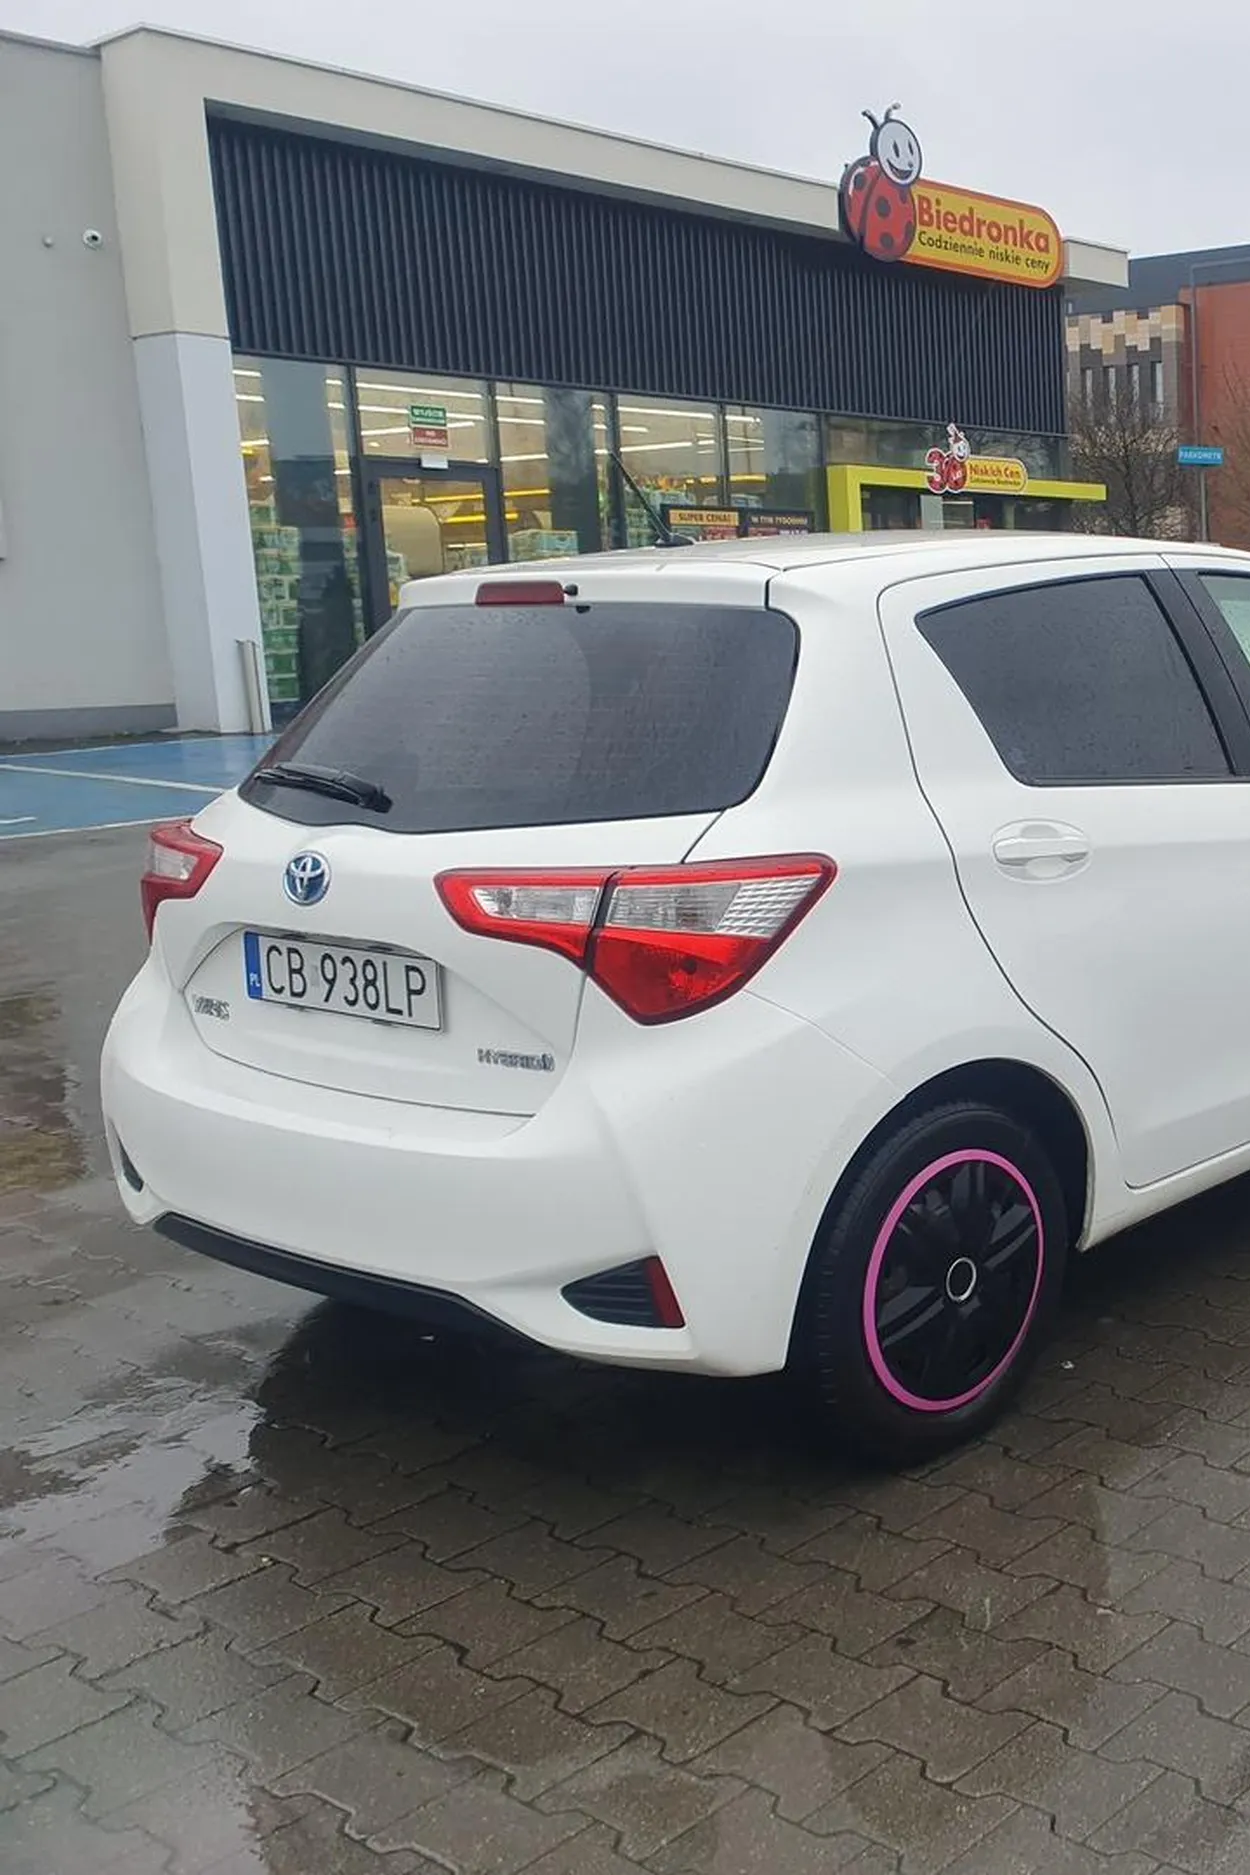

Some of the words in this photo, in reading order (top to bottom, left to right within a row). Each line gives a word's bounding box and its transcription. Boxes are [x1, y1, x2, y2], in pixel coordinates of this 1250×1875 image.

[917, 194, 1049, 254] Biedronka
[918, 231, 985, 259] Codziennie
[988, 248, 1021, 266] niskie
[1025, 258, 1051, 274] ceny
[678, 511, 703, 522] SUPER
[266, 945, 307, 998] CB
[320, 952, 426, 1018] 938LP
